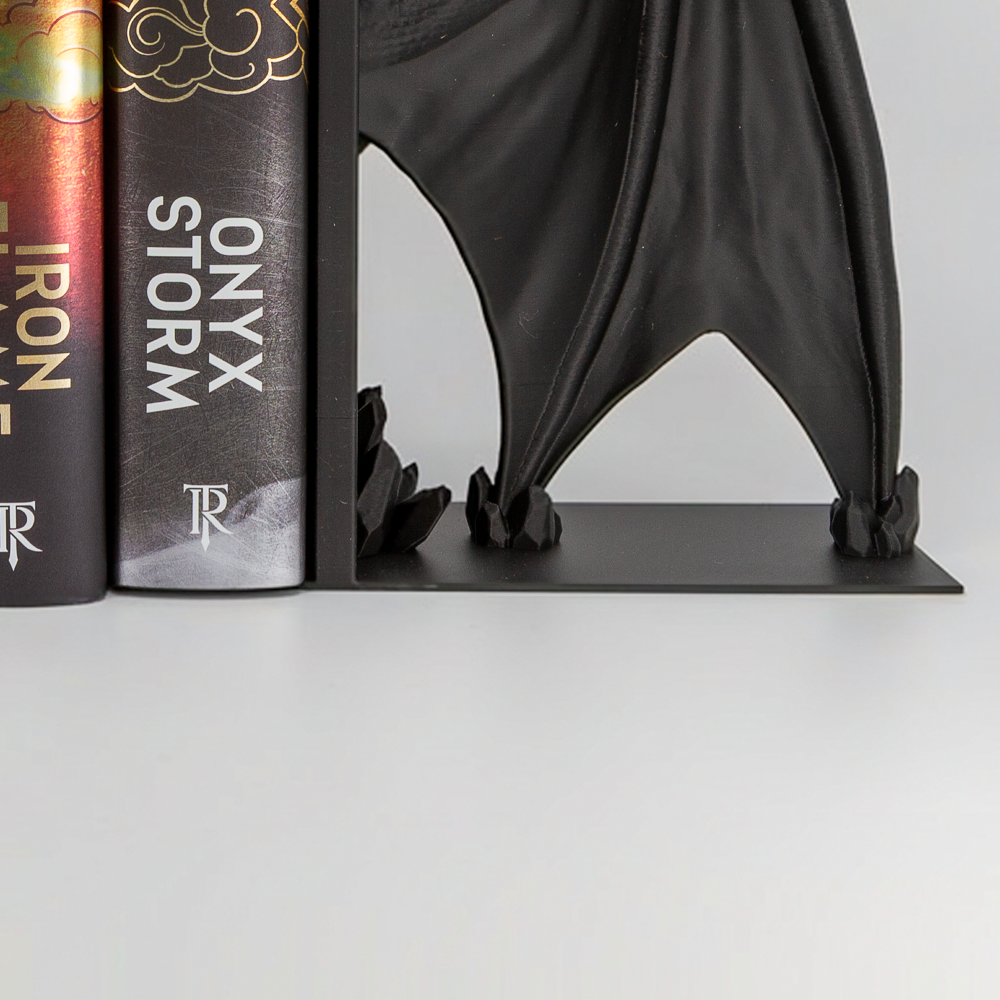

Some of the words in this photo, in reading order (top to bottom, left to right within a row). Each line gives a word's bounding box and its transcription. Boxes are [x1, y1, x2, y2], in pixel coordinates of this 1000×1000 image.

[14, 244, 72, 391] IRON
[146, 195, 201, 414] STORM
[209, 216, 264, 393] ONYX
